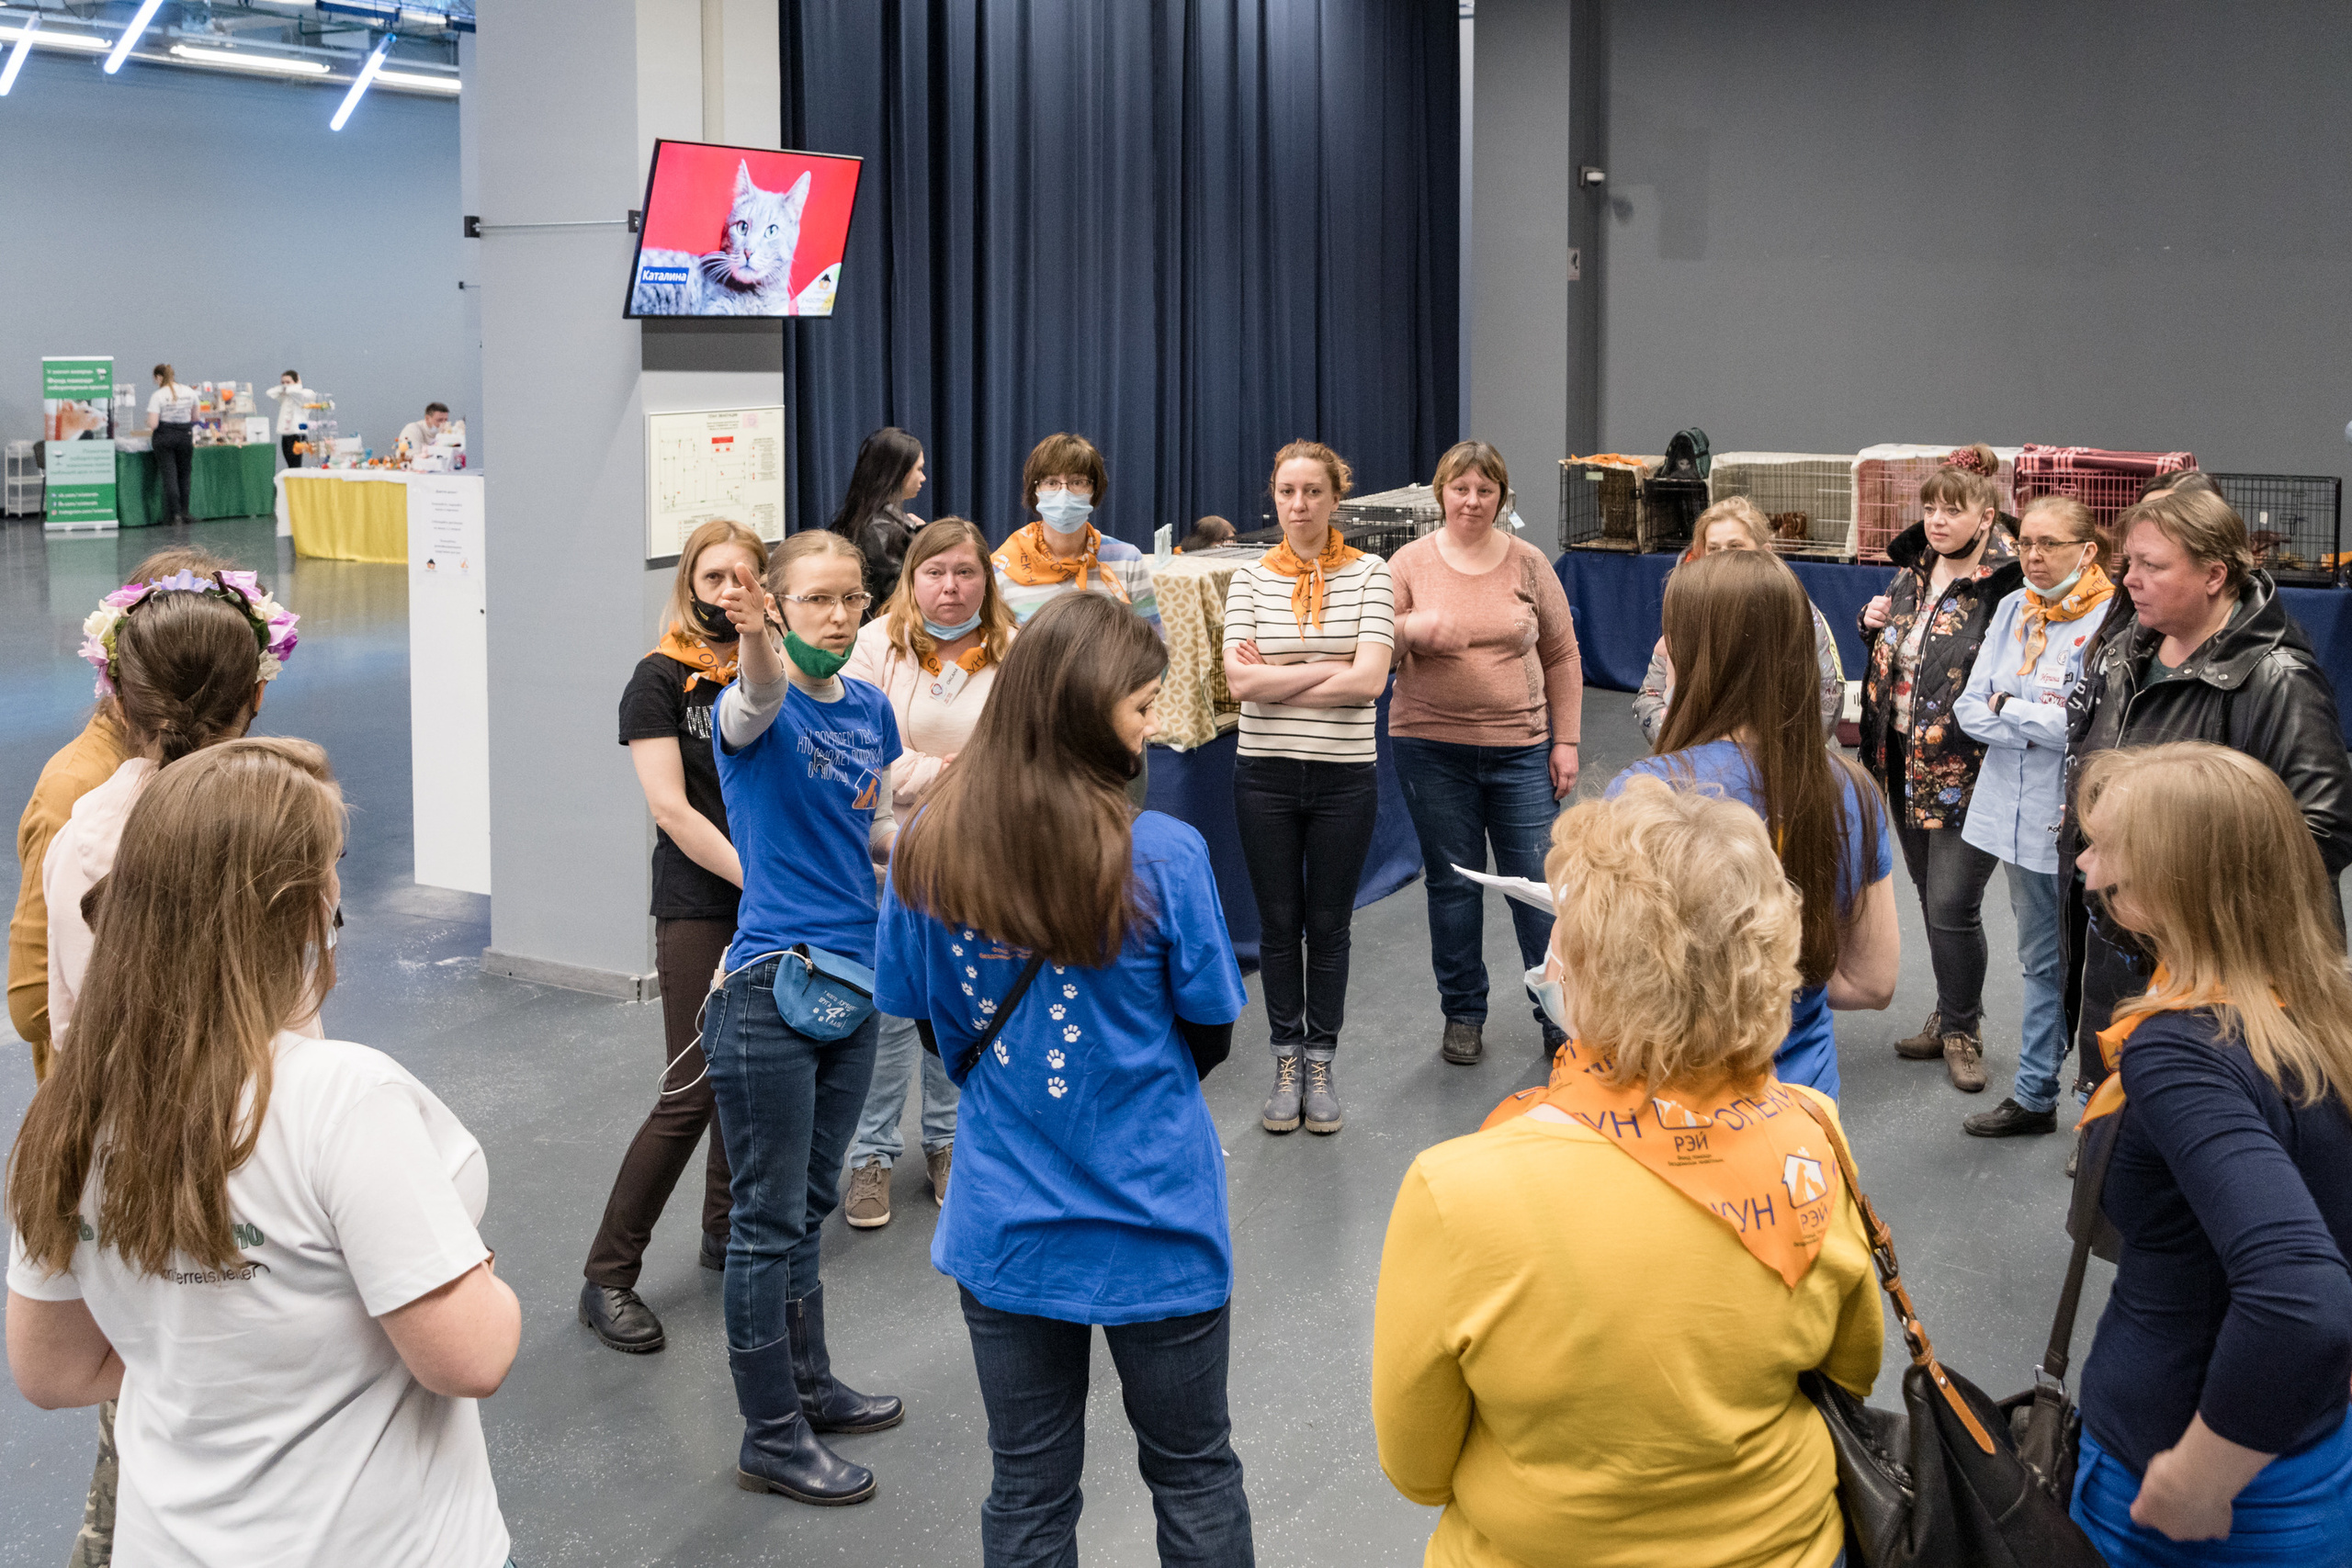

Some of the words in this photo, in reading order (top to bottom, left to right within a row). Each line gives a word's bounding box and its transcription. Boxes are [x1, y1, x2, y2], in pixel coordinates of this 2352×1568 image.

[642, 269, 687, 282] Каталина
[797, 735, 813, 755] КТО
[825, 1007, 844, 1023] 4
[1714, 1085, 1793, 1131] ОПЕКУ
[1575, 1110, 1642, 1138] УН
[1673, 1131, 1709, 1153] РЭЙ
[1800, 1201, 1828, 1231] РЭЙ
